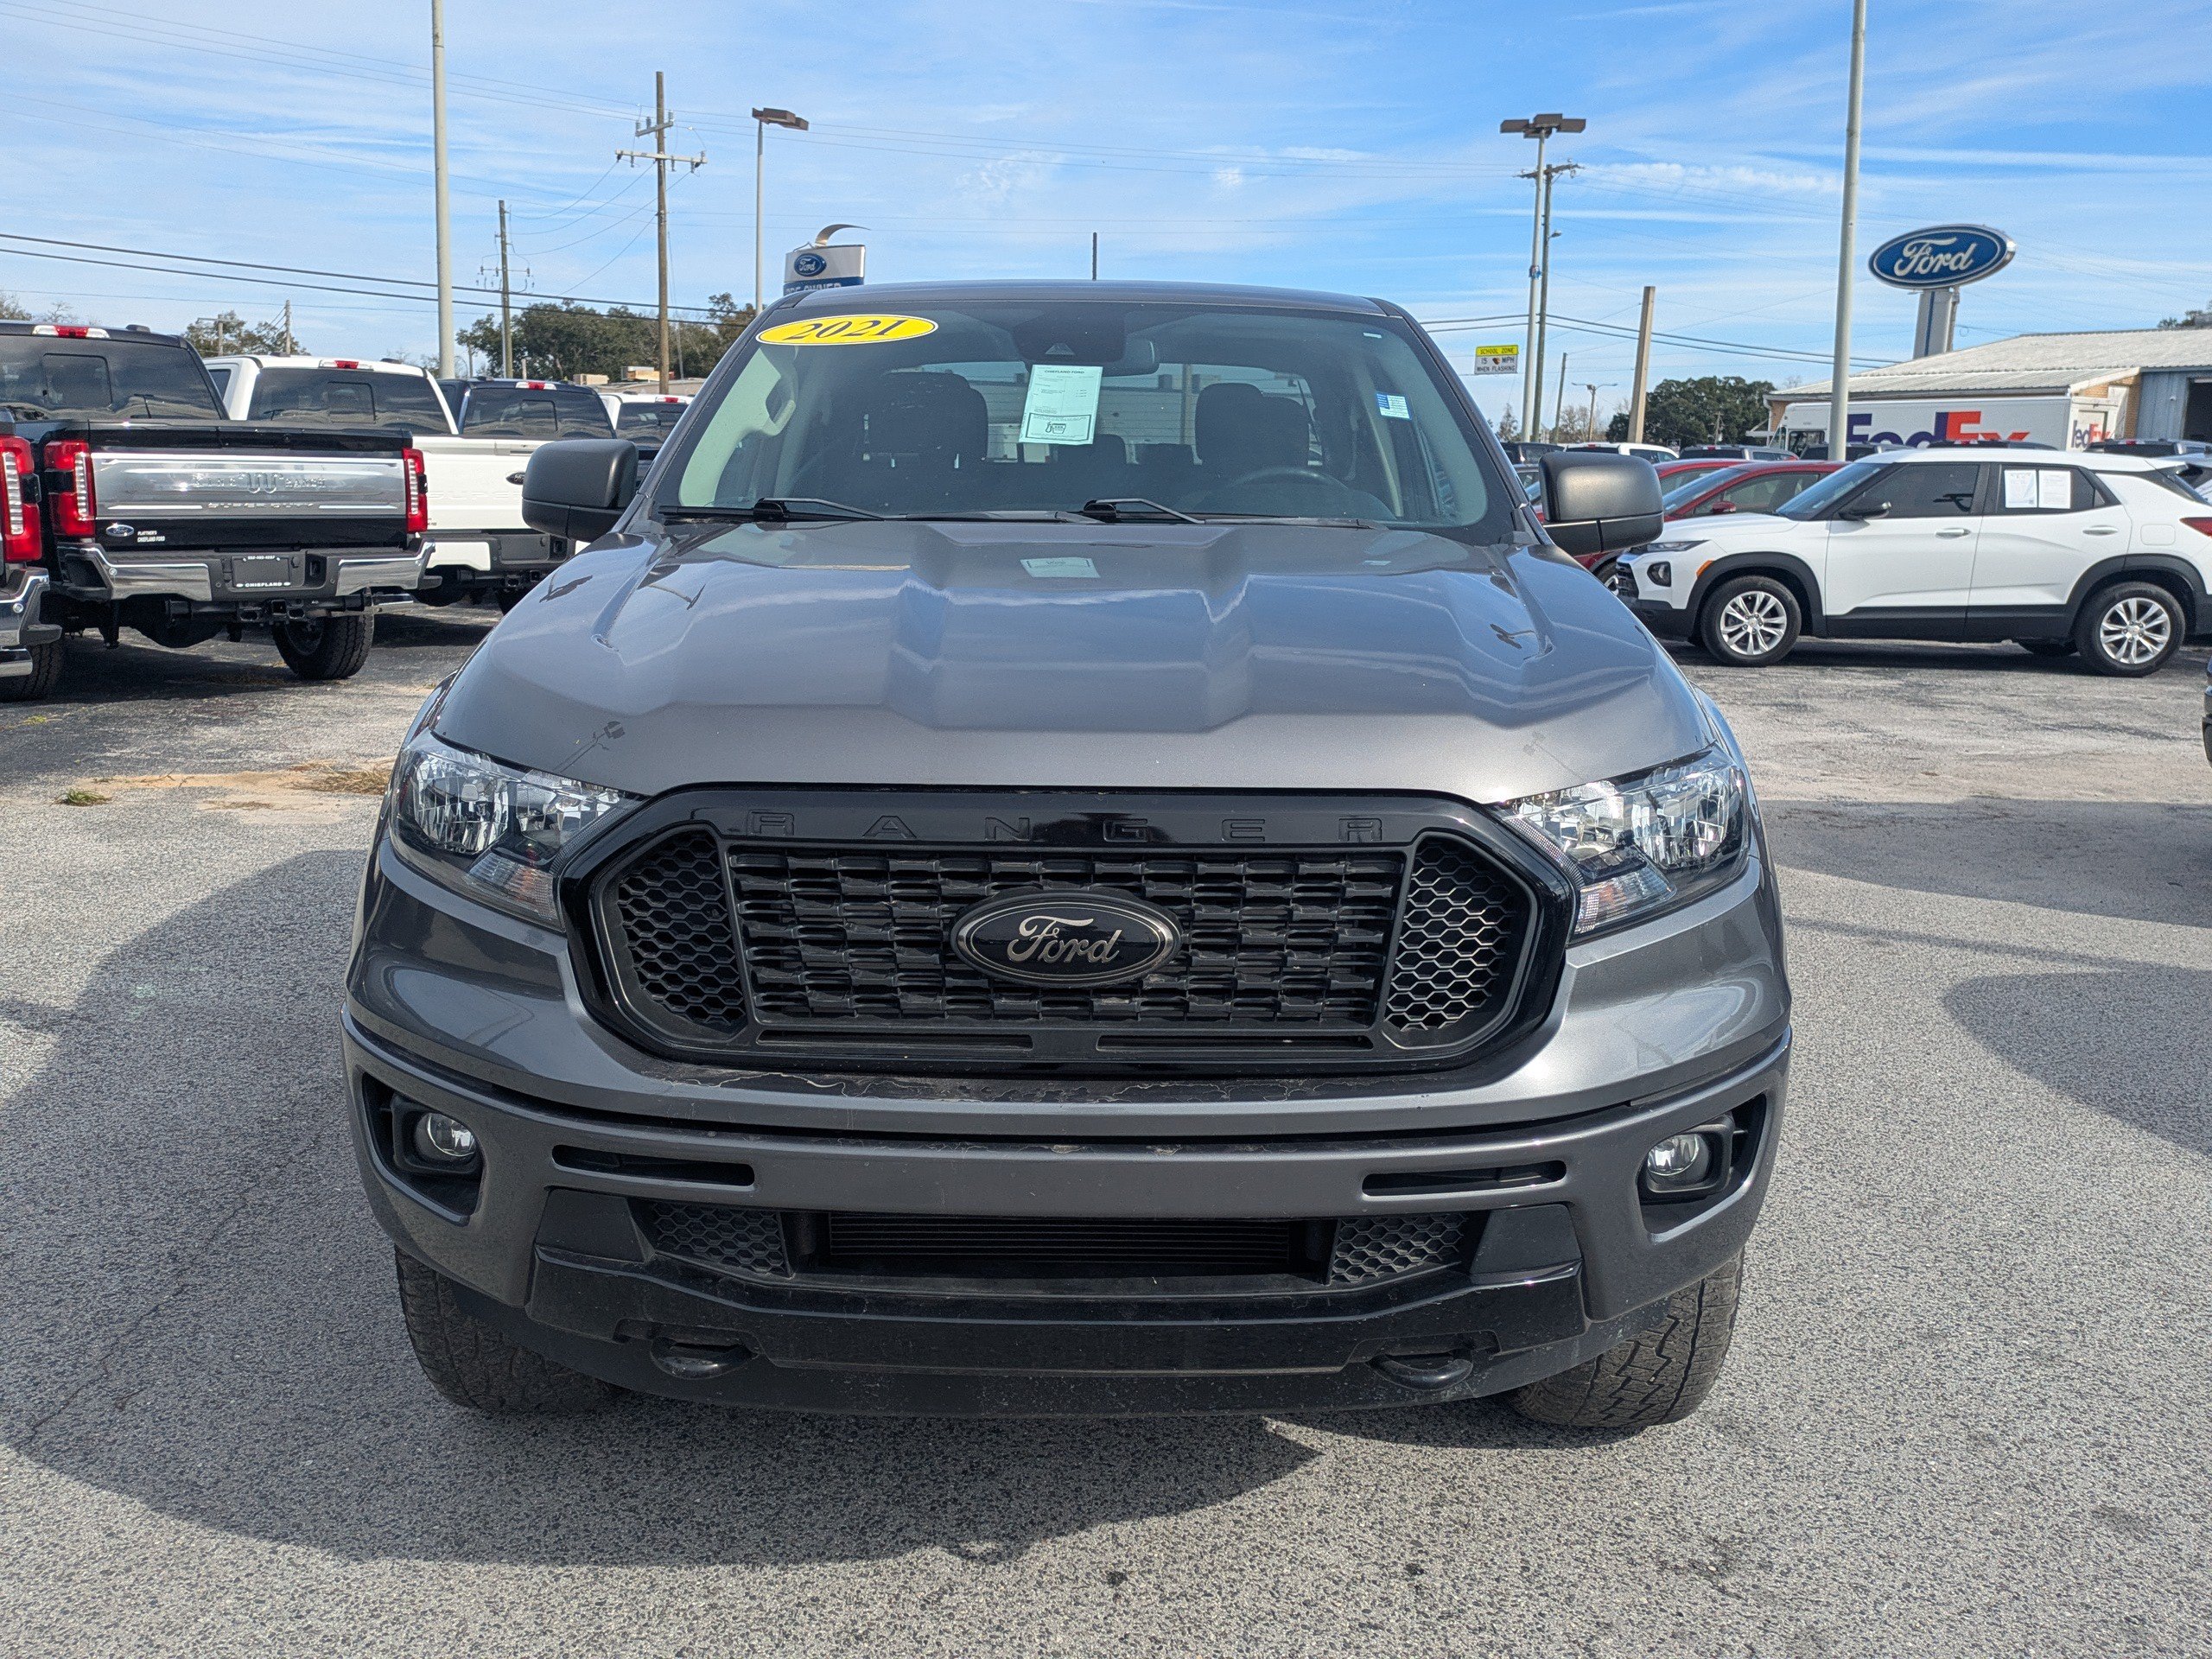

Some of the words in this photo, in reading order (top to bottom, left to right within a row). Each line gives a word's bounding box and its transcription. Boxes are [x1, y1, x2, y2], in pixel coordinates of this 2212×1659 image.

[798, 257, 817, 271] Ford
[1894, 237, 1978, 276] Ford
[782, 320, 909, 340] 2021
[1846, 410, 2031, 448] FdE
[748, 810, 1384, 842] RANGER
[1007, 915, 1122, 965] Ford
